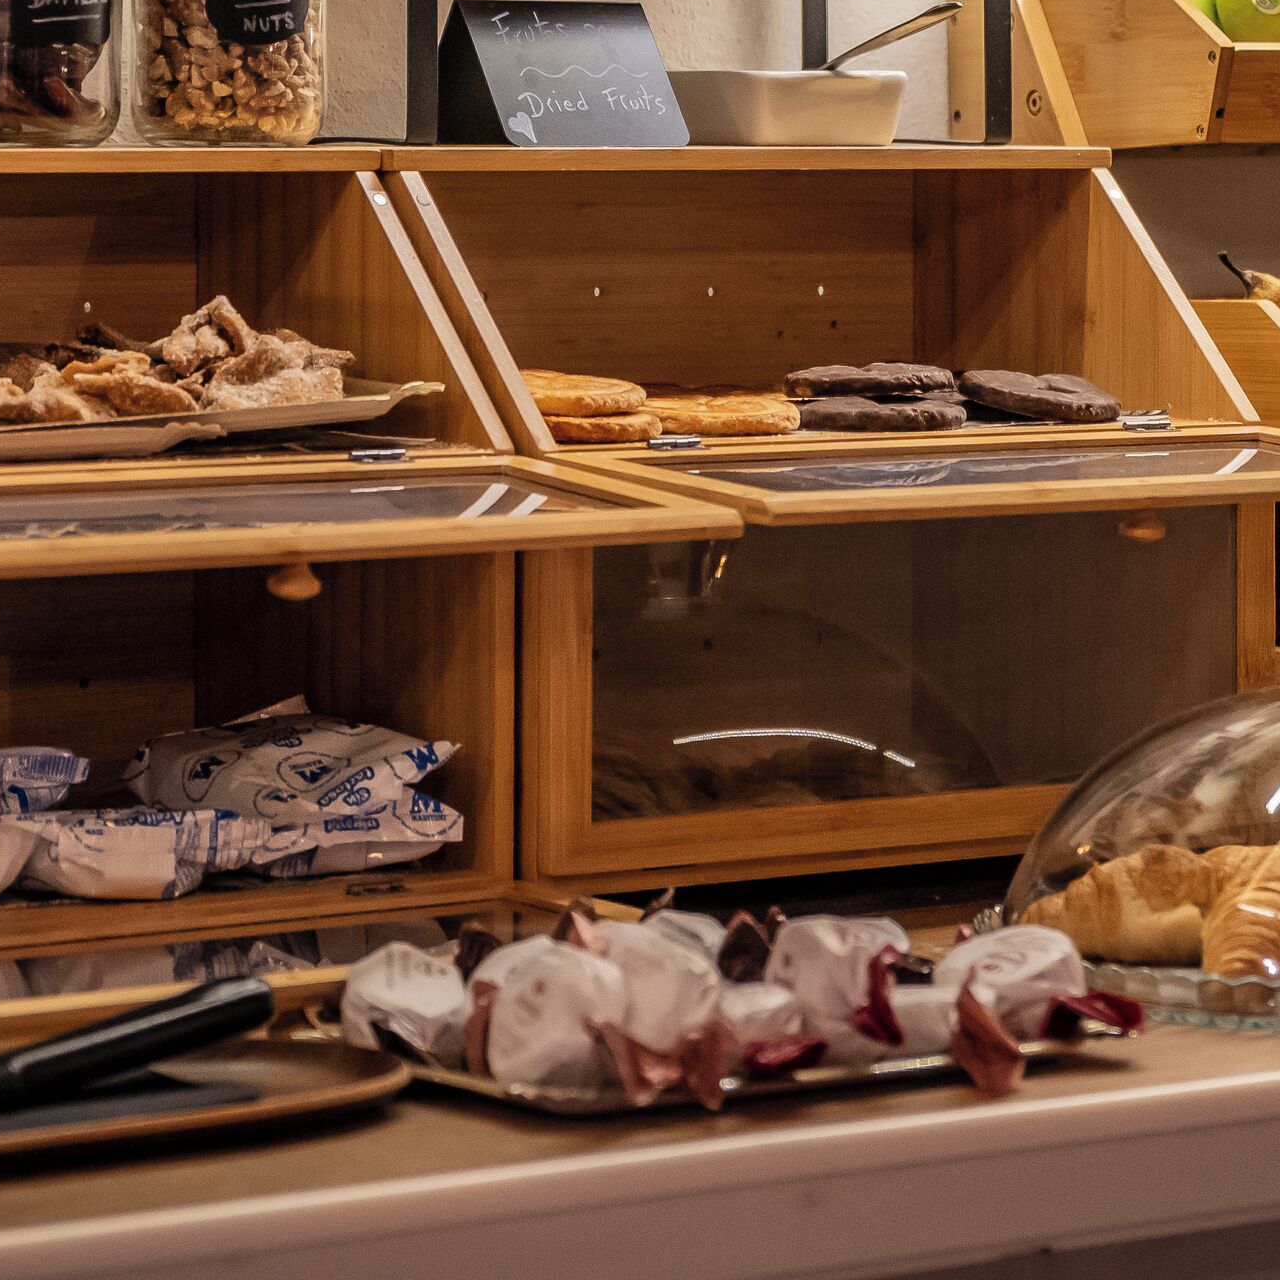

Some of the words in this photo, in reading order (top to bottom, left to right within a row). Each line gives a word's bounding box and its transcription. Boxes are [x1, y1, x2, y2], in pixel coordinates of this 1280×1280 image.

[243, 11, 295, 33] NUTS
[517, 90, 589, 118] Dried
[601, 84, 666, 116] Fruits
